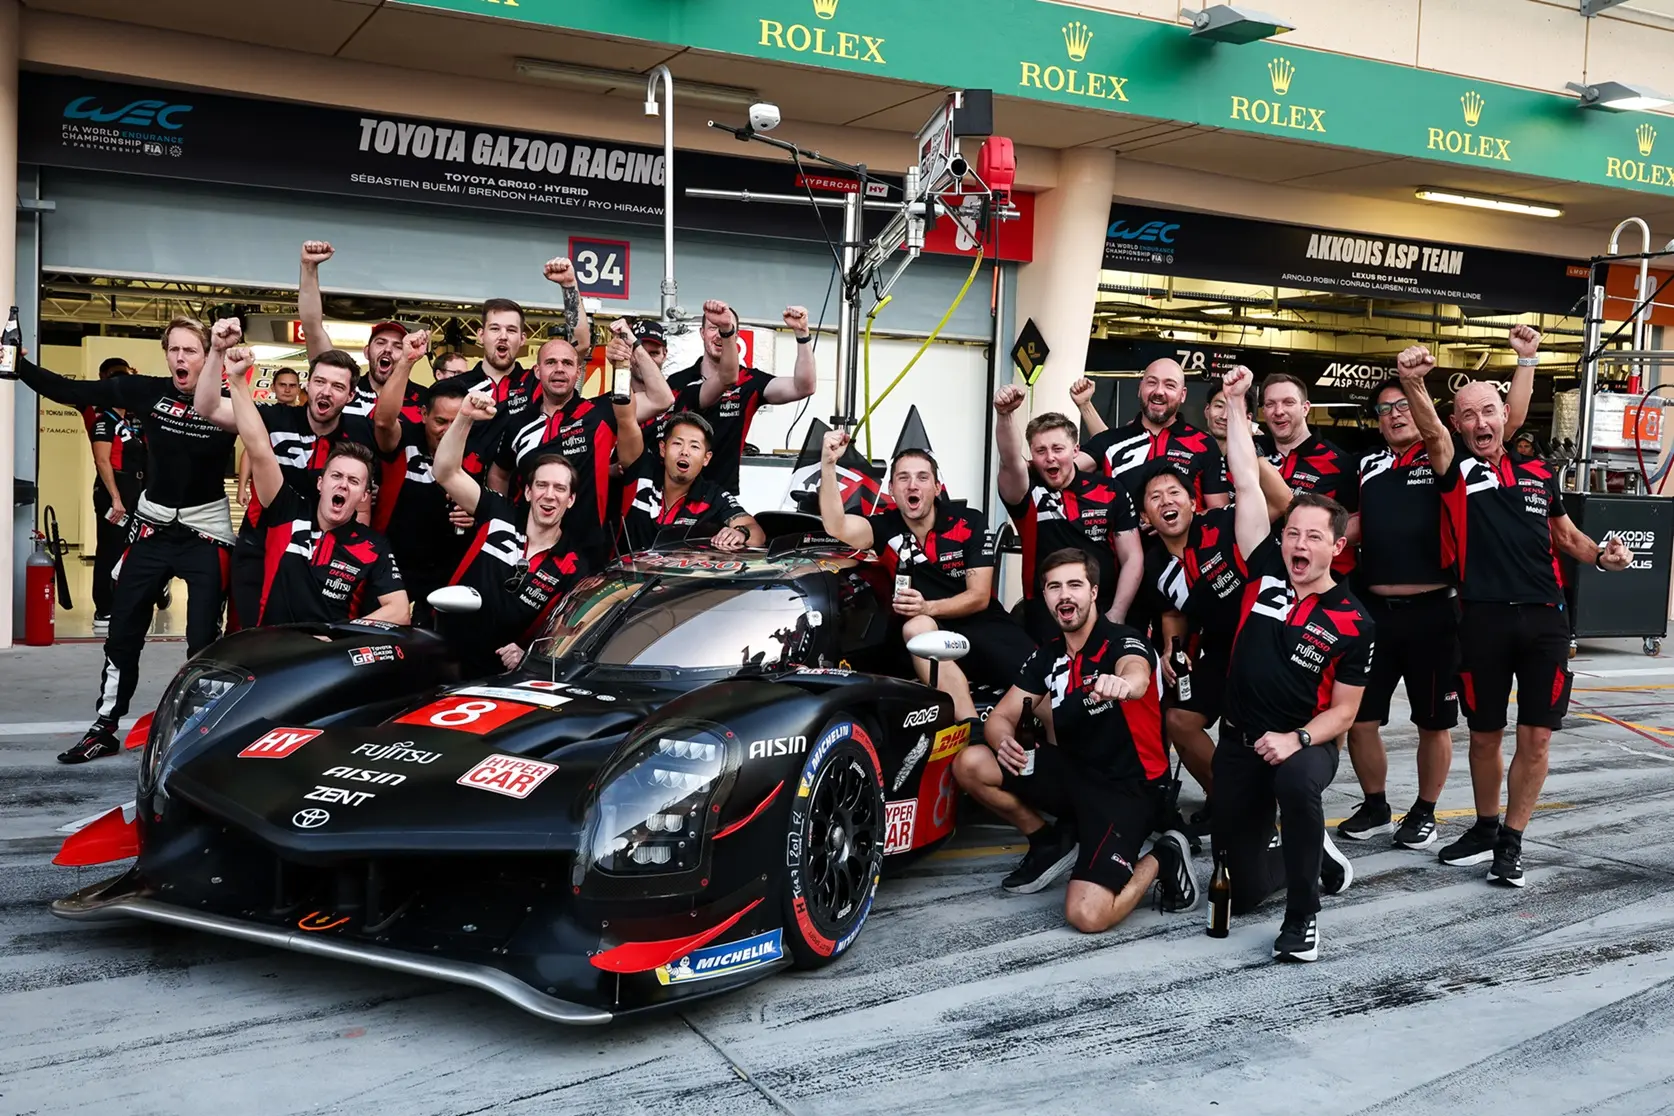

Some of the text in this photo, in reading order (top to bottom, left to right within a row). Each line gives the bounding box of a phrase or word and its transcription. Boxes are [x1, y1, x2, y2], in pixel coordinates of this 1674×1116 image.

[758, 19, 886, 64] ROLEX
[1019, 62, 1130, 103] ROLEX
[63, 96, 193, 130] WEC
[1230, 96, 1327, 133] ROLEX
[62, 124, 184, 144] FIA WORLD ENDURANCE
[62, 132, 142, 147] CHAMPIONSHIP
[1427, 127, 1512, 162] ROLEX
[359, 118, 665, 187] TOYOTA GAZOO RACING
[1605, 157, 1674, 188] ROLEX
[350, 172, 420, 189] SÉBASTIEN
[422, 181, 460, 193] BUEMI
[468, 186, 526, 201] BRENDON
[529, 193, 581, 207] HARTLEY
[588, 200, 612, 210] RYO
[614, 203, 665, 216] HIRAKAW
[444, 172, 496, 186] TOYOTA
[498, 179, 536, 191] GR010
[544, 184, 589, 196] HYBRID
[801, 178, 858, 191] HYPERCAR
[868, 185, 885, 193] HY
[1106, 219, 1180, 244] WEC
[1105, 247, 1151, 257] CHAMPIONSHIP
[1305, 233, 1464, 276] AKKODIS ASP TEAM
[576, 251, 623, 287] 34
[1351, 271, 1376, 281] LEXUS
[1376, 273, 1387, 282] RC
[1393, 275, 1418, 285] LMGT3
[1569, 268, 1591, 276] LMGT
[1281, 273, 1312, 283] ARNOLD
[1313, 276, 1336, 285] ROBIN
[1340, 279, 1371, 289] CONRAD
[1371, 282, 1404, 292] LAURSEN
[1408, 286, 1432, 295] KELVIN
[1432, 288, 1447, 297] VAN
[1447, 290, 1461, 298] DER
[1462, 291, 1482, 300] LINDE
[1333, 378, 1352, 388] ASP
[562, 435, 586, 447] FUJITSU
[563, 446, 580, 456] Mobil
[1406, 478, 1426, 486] Mobil
[1525, 505, 1542, 514] Mobil
[1084, 518, 1107, 526] DENSO
[328, 568, 356, 582] DENSO
[1625, 560, 1653, 569] XUS
[325, 578, 351, 592] FUJITSU
[1211, 569, 1234, 591] FUJITSU
[321, 588, 341, 600] Mobil
[519, 593, 536, 608] Mobil
[525, 585, 549, 602] FUJITSU
[1218, 584, 1235, 599] Mobil
[944, 640, 962, 649] Mobil
[1302, 632, 1331, 652] DENSO
[353, 653, 374, 664] GR
[395, 645, 404, 660] 8
[1290, 653, 1312, 669] Mobil
[1295, 643, 1325, 664] FUJITSU
[429, 700, 498, 726] 8
[903, 705, 940, 729] RAYS
[1088, 703, 1108, 716] Mobil
[257, 732, 307, 753] HY
[749, 735, 807, 760] AISIN
[811, 724, 849, 771] MICHELIN
[938, 728, 968, 752] DHL
[350, 741, 443, 765] FUJITSU
[322, 766, 407, 787] AISIN
[486, 756, 549, 778] HYPER
[468, 766, 535, 793] CAR
[303, 785, 376, 807] ZENT
[885, 804, 913, 823] YPER
[885, 822, 911, 849] AR
[696, 939, 778, 971] MICHELIN
